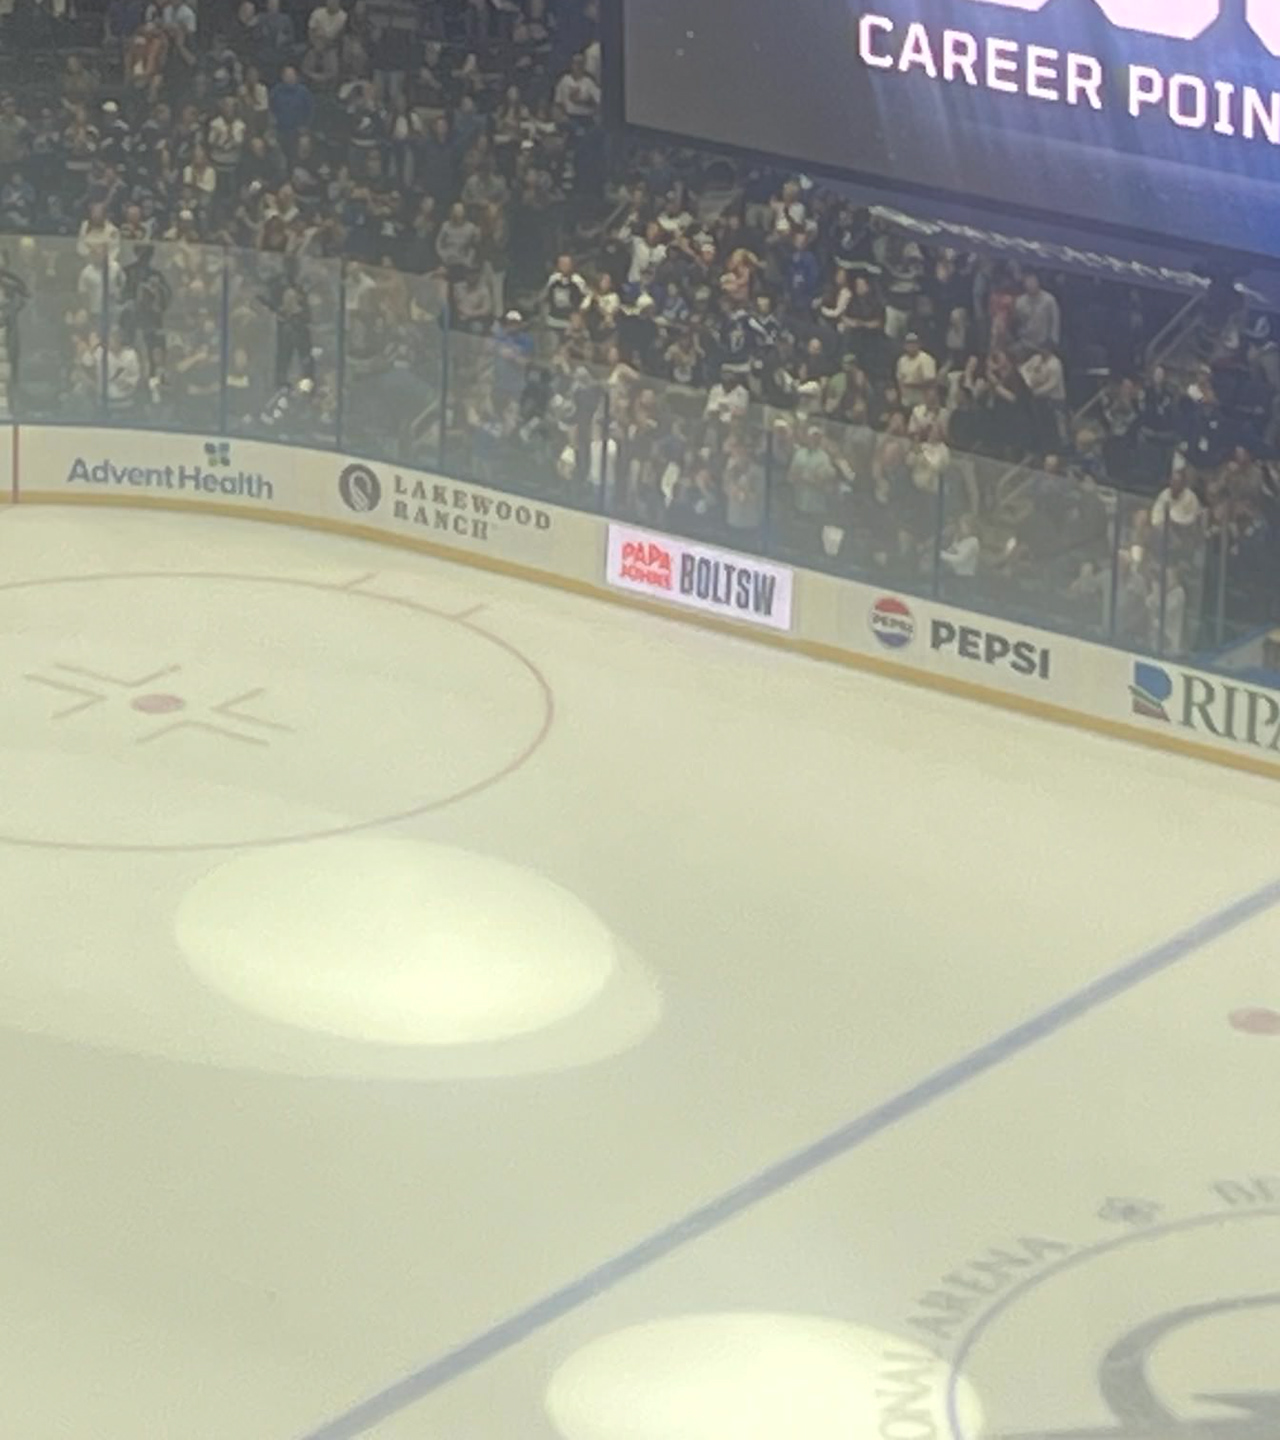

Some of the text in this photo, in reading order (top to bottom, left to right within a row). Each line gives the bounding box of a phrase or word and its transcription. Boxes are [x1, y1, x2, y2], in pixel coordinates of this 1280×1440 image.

[858, 15, 1102, 110] CAREER
[66, 457, 274, 500] AdventHealth
[394, 474, 551, 530] LAKEWOOD
[394, 500, 488, 540] RANCH
[621, 540, 672, 571] PAPA
[680, 552, 777, 616] BOLTSW
[930, 618, 1051, 680] PEPSI
